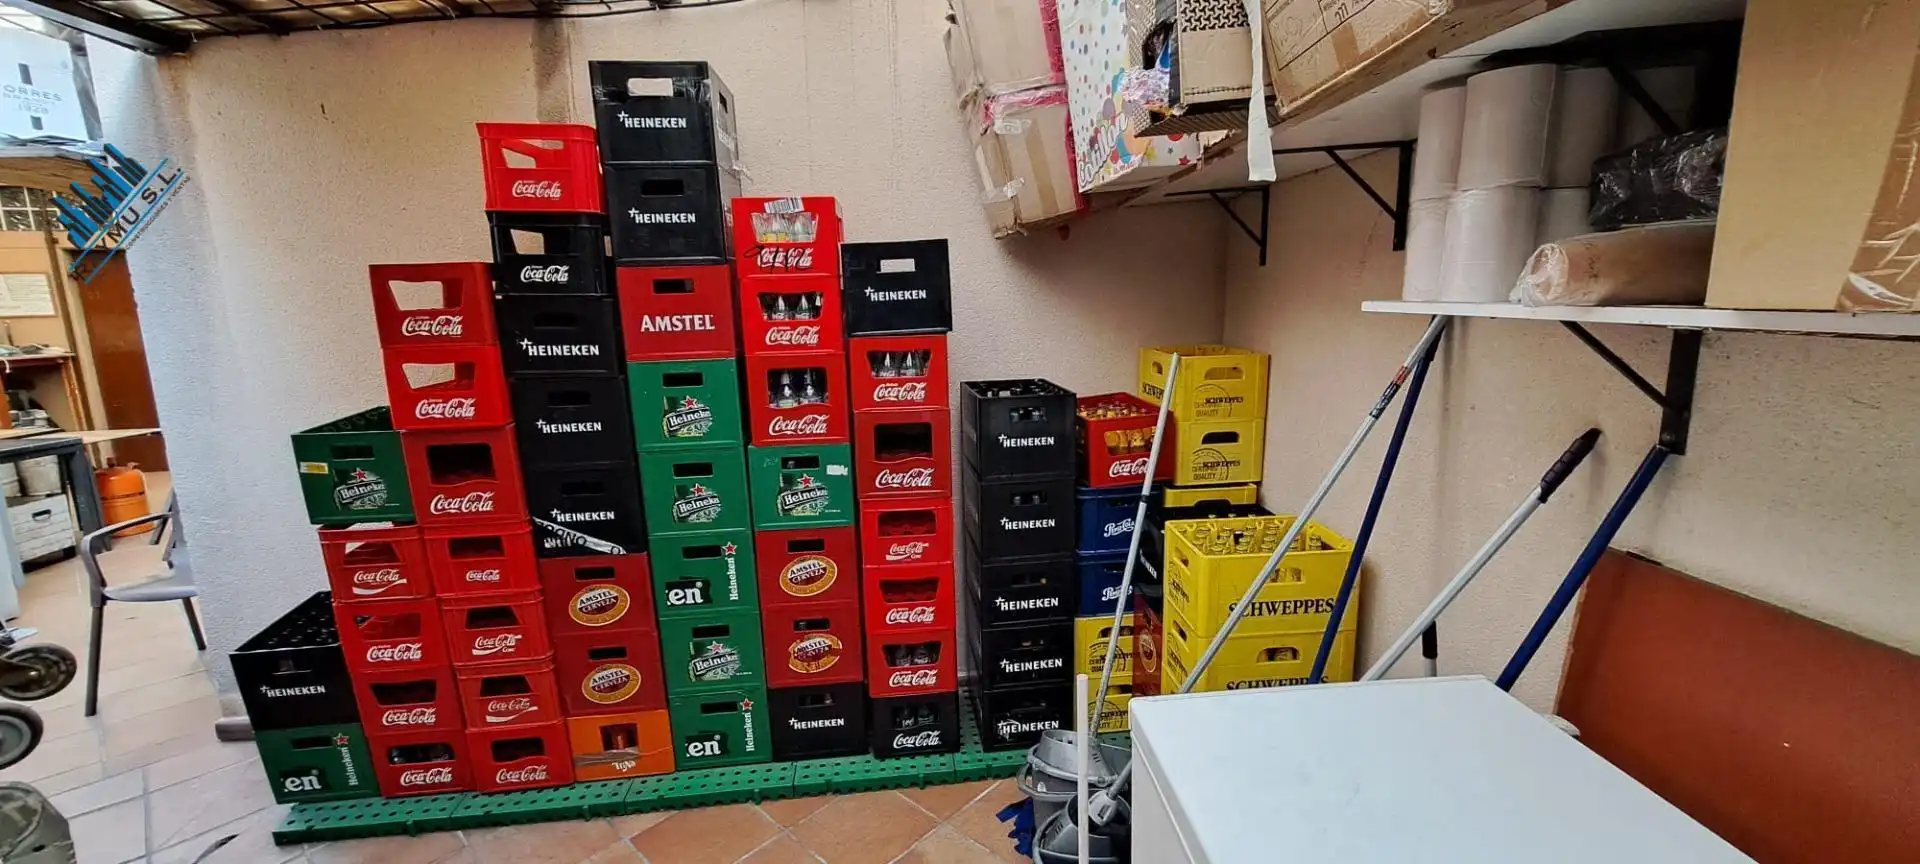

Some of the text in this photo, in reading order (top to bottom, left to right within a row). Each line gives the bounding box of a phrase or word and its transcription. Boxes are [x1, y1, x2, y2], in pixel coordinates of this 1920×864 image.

[3, 84, 63, 101] ORRES
[625, 117, 687, 129] HEINEKEN
[512, 179, 562, 198] Coca-Cola
[635, 213, 696, 224] HEINEKEN
[520, 264, 570, 283] Coca-Cola
[870, 289, 927, 301] HEINEKEN
[401, 315, 464, 337] Coca-Cola
[640, 314, 715, 333] AMSTEL
[765, 325, 821, 345] Coca-Cola
[528, 345, 600, 356] HEINEKEN
[873, 381, 927, 402] Coca-Cola
[415, 397, 476, 419] Coca-Cola
[542, 422, 602, 433] HEINEKEN
[769, 414, 831, 436] Coca-Cola
[1003, 437, 1055, 447] HEINEKEN
[875, 468, 935, 489] Coca-Cola
[430, 490, 494, 515] Coca-Cola
[557, 511, 615, 522] HEINEKEN
[1005, 518, 1055, 530] HEINEKEN
[889, 541, 924, 555] Coca-Cola
[353, 568, 400, 584] Coca-Cola
[466, 569, 501, 582] Coca-Cola
[789, 561, 823, 577] AMSTEL
[726, 556, 739, 601] Heineken
[579, 589, 613, 607] AMSTEL
[582, 597, 617, 613] CERVEZA
[1001, 598, 1059, 611] HEINEKEN
[885, 606, 936, 624] Coca-Cola
[474, 633, 517, 649] Coca-Cola
[366, 642, 422, 662] Coca-Cola
[1005, 658, 1063, 673] HEINEKEN
[591, 669, 626, 685] AMSTEL
[594, 677, 628, 692] CERVEZA
[888, 669, 938, 688] Coca-Cola
[267, 685, 326, 697] HEINEKEN
[382, 707, 437, 726] Coca-Cola
[794, 717, 845, 730] HEINEKEN
[743, 711, 755, 752] Heineken
[1001, 721, 1059, 735] HEINEKEN
[893, 730, 941, 749] Coca-Cola
[341, 745, 358, 786] Heineken
[495, 764, 548, 784] Coca-Cola
[400, 767, 453, 786] Coca-Cola
